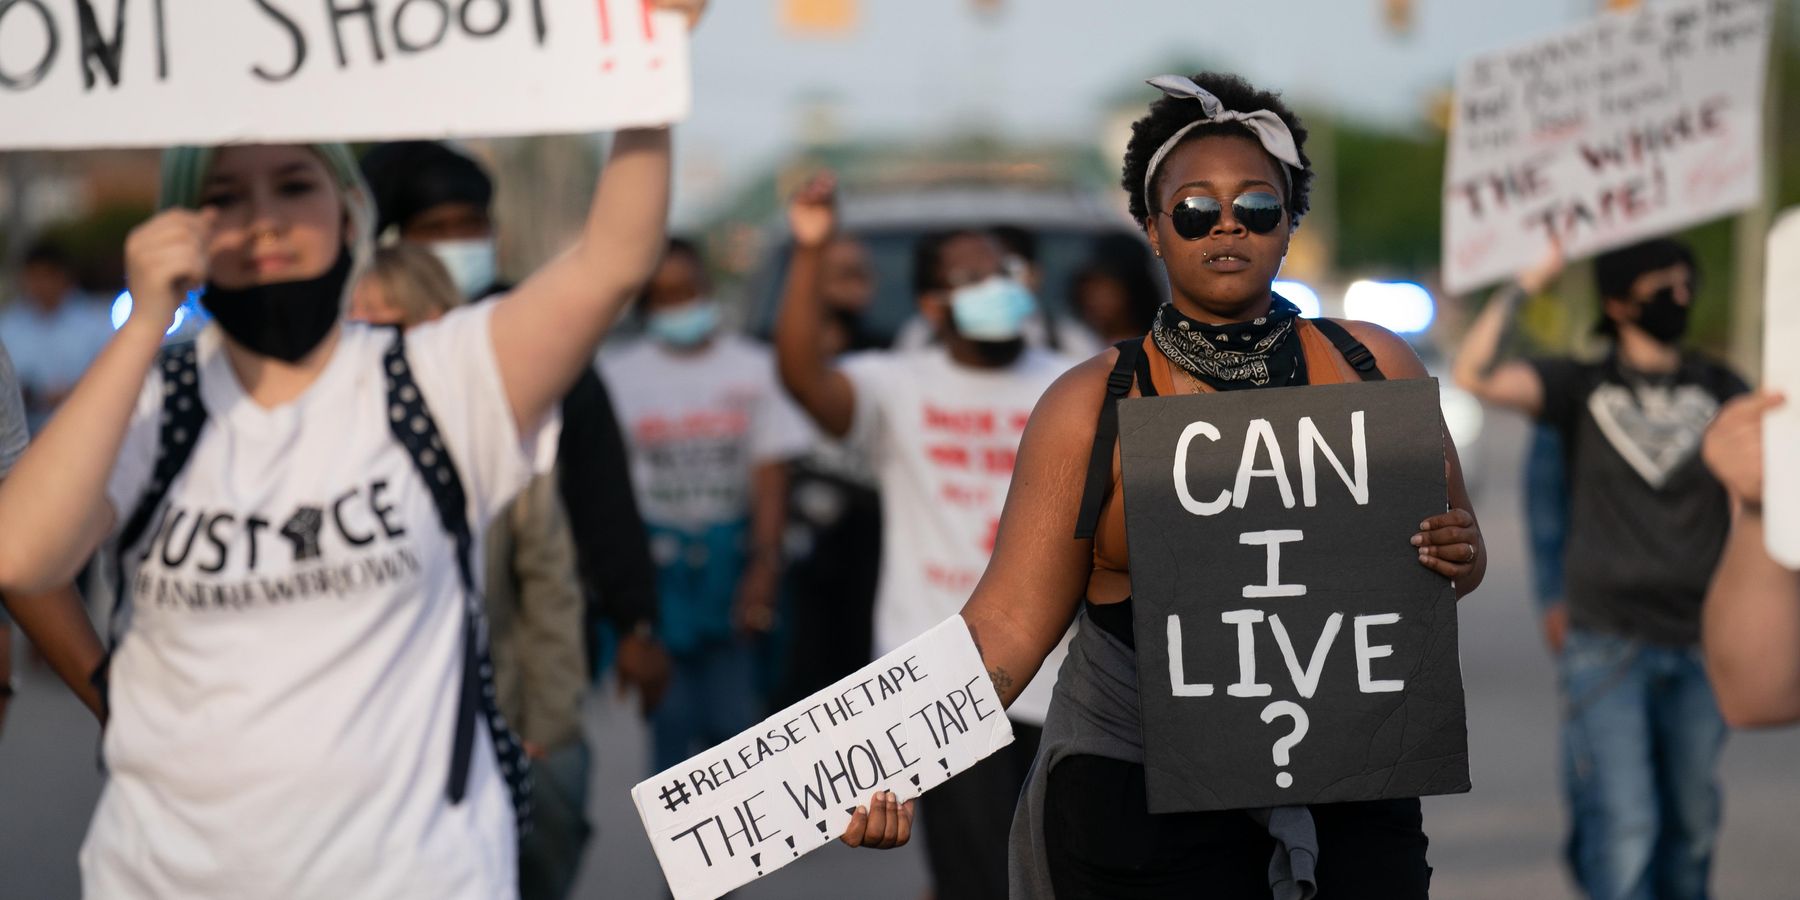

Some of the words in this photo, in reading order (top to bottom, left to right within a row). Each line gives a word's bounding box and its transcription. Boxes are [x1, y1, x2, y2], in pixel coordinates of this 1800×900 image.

[1447, 155, 1552, 220] THE
[1577, 94, 1731, 171] WHOLE
[1172, 410, 1370, 517] CAN
[1238, 529, 1307, 599] I
[1166, 608, 1405, 700] LIVE
[658, 655, 928, 812] #RELEASETHETAPE
[670, 790, 781, 867] THE
[782, 722, 921, 820] WHOLE
[909, 675, 996, 749] TAPE
[1259, 700, 1310, 789] ?
